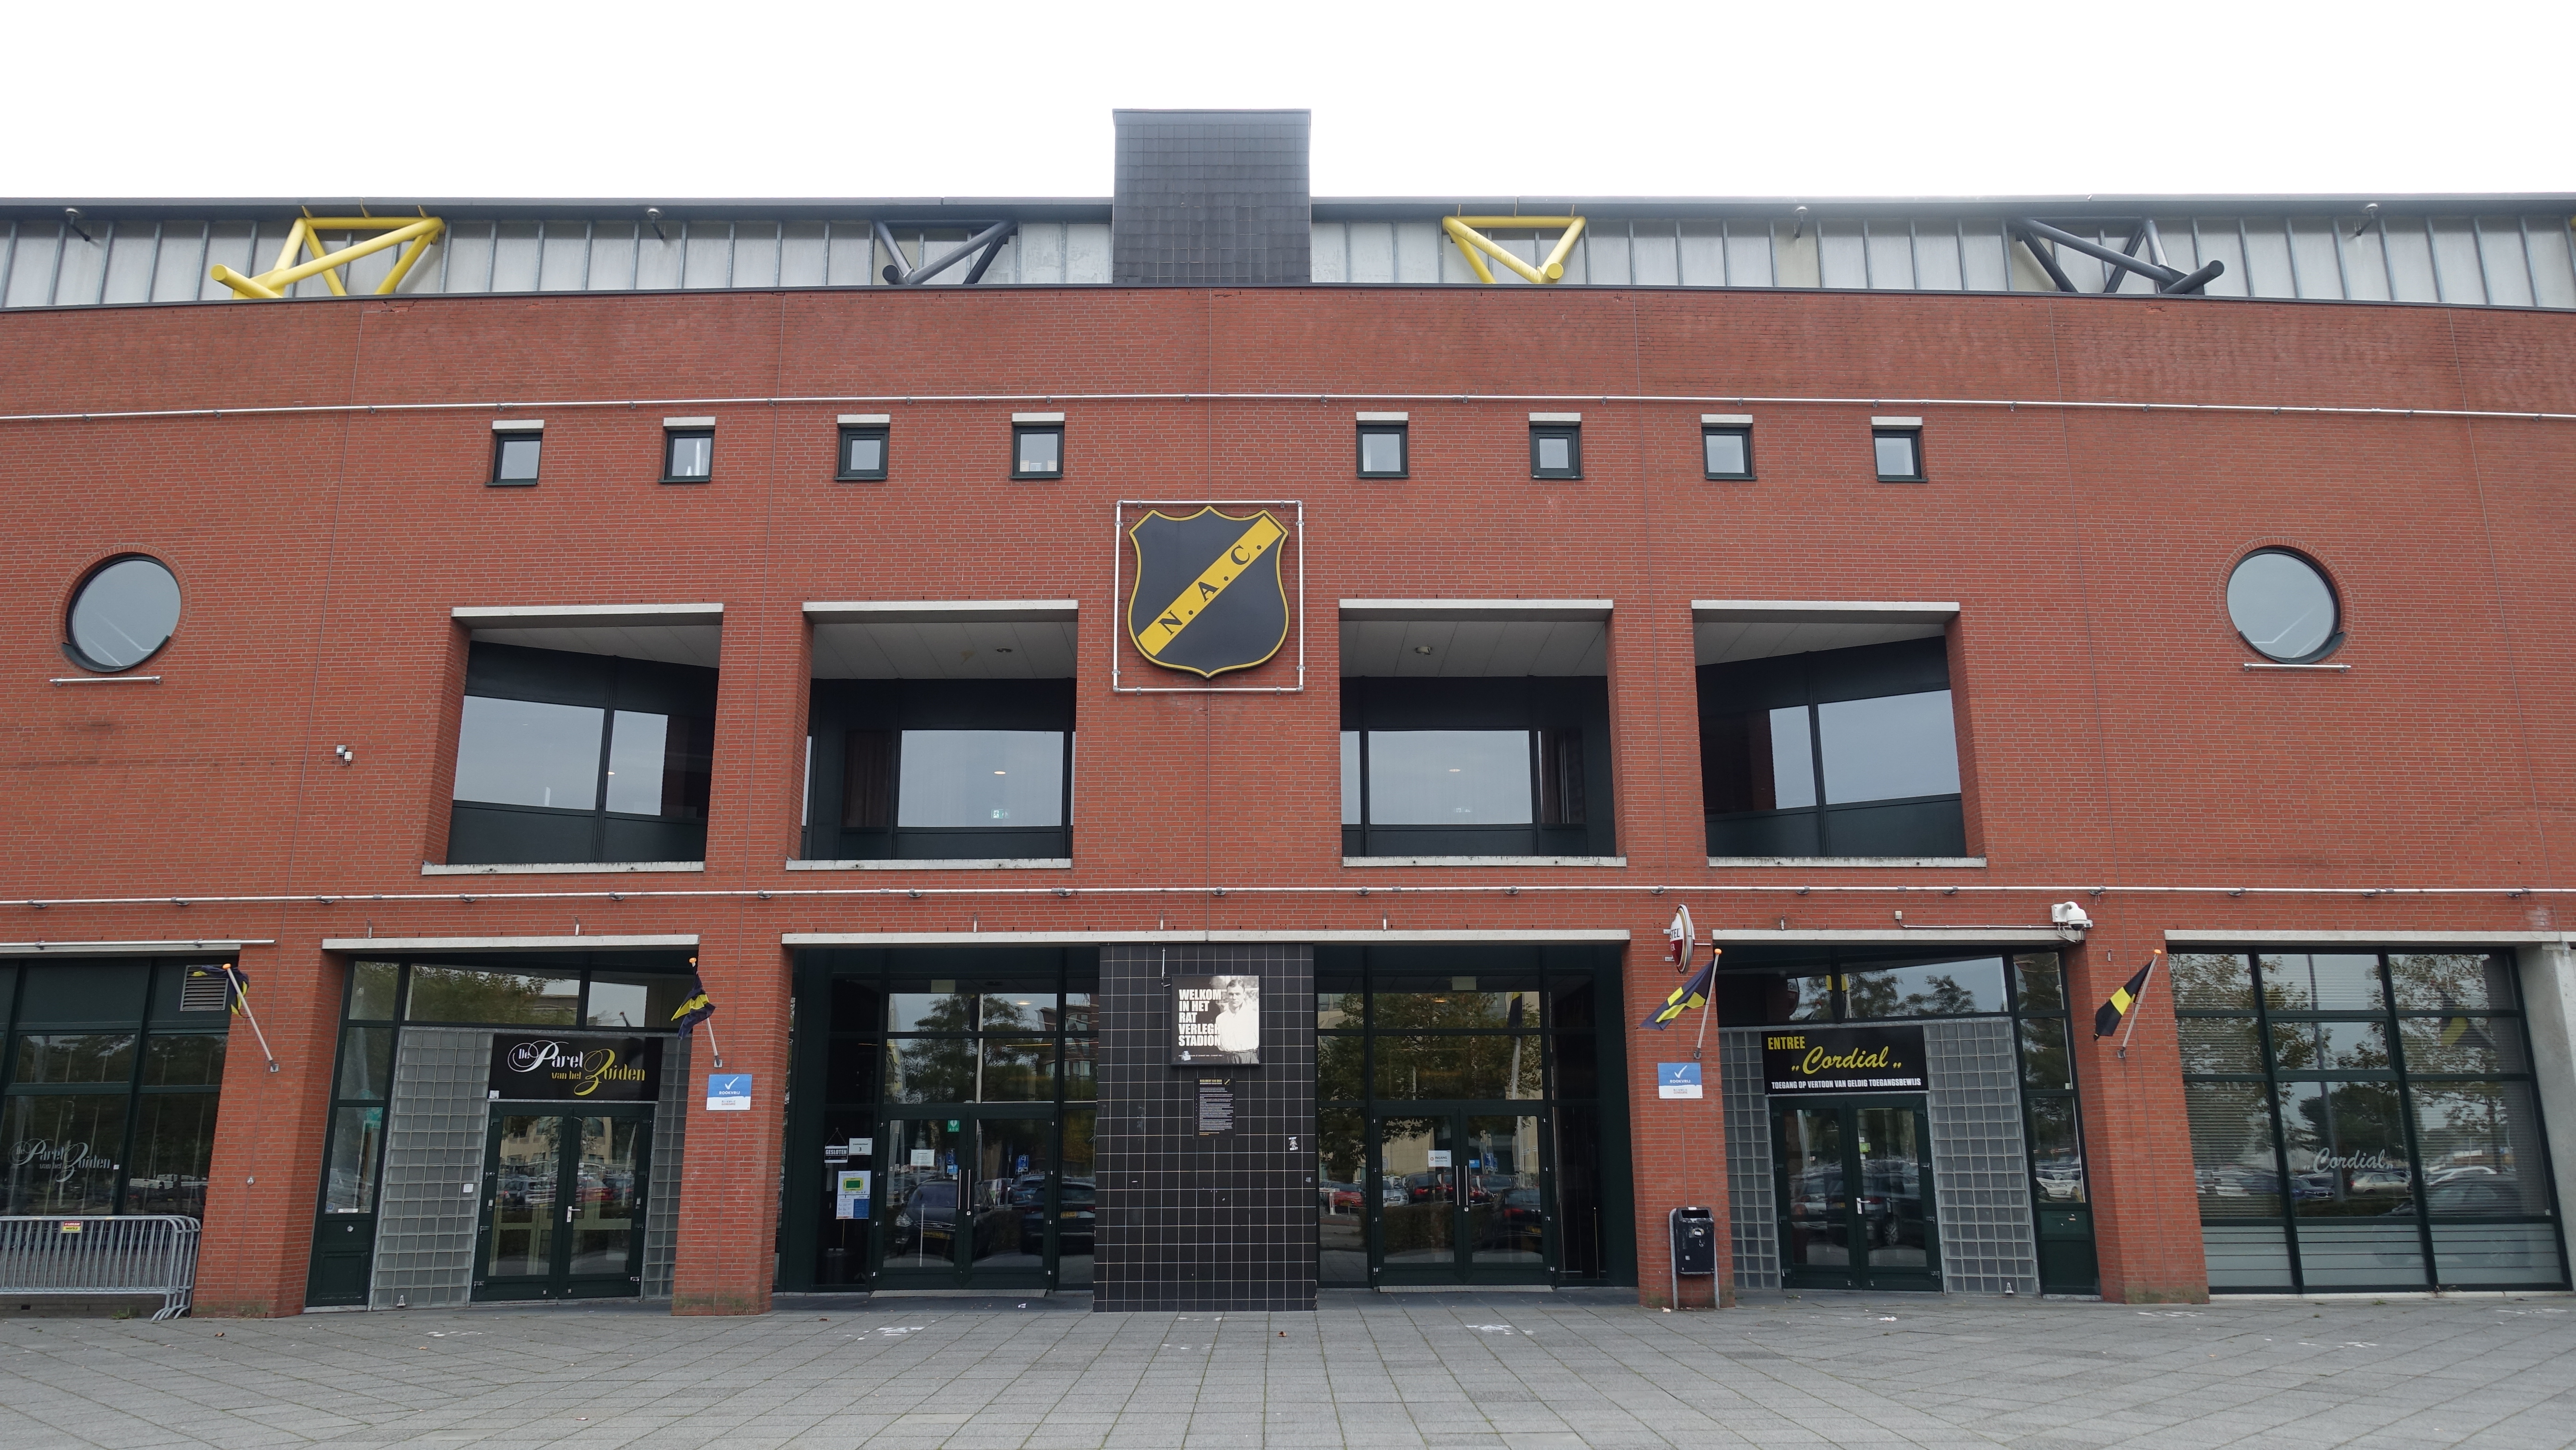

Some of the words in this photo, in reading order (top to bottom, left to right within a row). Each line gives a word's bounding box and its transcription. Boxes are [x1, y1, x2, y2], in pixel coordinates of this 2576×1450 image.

[1179, 989, 1221, 1000] WELKOM
[1179, 1001, 1189, 1012] IN
[1191, 1001, 1210, 1012] HET
[1179, 1012, 1197, 1023] RAT
[1178, 1023, 1221, 1034] VERLEGH
[1178, 1035, 1221, 1046] STADION
[1768, 1036, 1806, 1050] ENTREE
[507, 1040, 583, 1072] Parel
[518, 1048, 530, 1059] De
[551, 1071, 567, 1079] van
[569, 1070, 582, 1079] het
[573, 1048, 645, 1096] Zuiden
[1771, 1081, 1797, 1089] TOEGANG
[1798, 1081, 1806, 1089] OP
[1807, 1080, 1834, 1088] VERTOON
[1835, 1080, 1846, 1088] VAN
[1847, 1079, 1868, 1088] GELDIG
[1868, 1078, 1922, 1087] TOEGANGSBEWIJS
[8, 1138, 64, 1165] Parel
[56, 1142, 111, 1182] Zuiden
